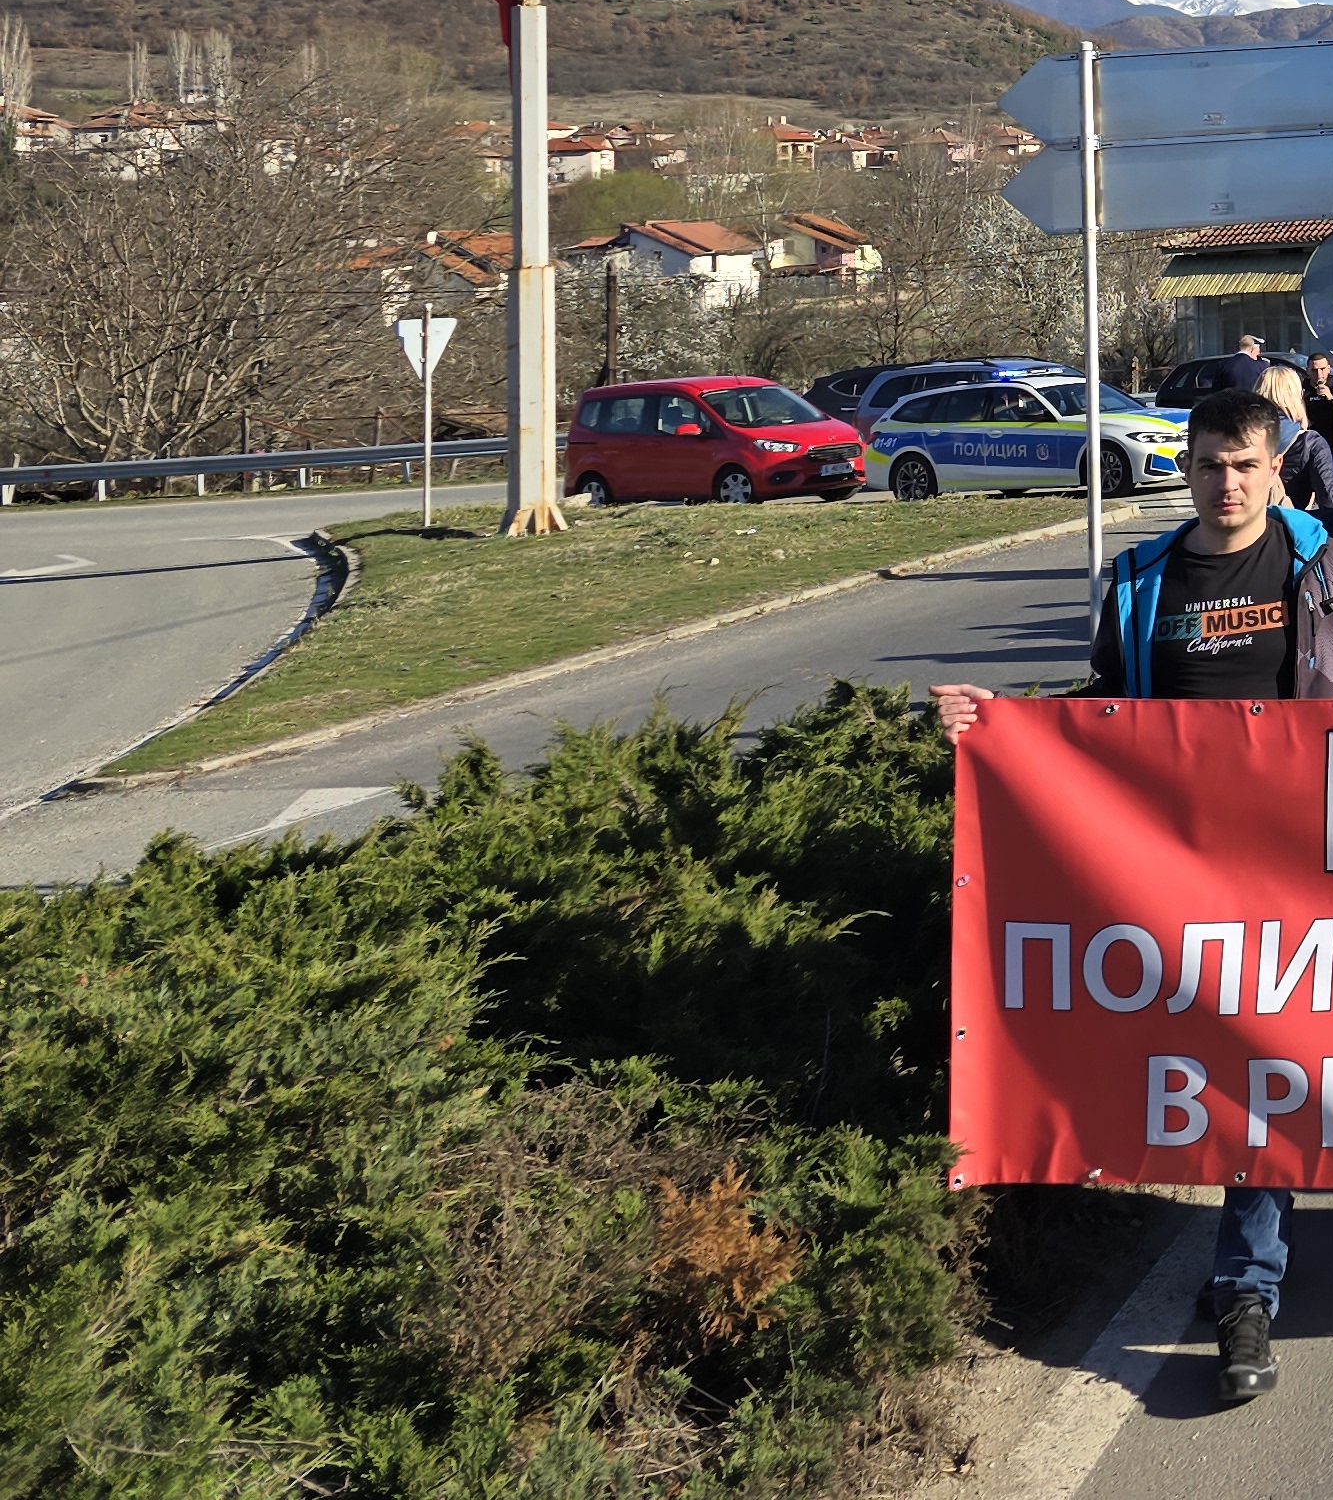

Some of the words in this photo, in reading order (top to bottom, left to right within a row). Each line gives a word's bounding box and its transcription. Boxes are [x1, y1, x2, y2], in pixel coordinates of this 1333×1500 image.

[953, 441, 1028, 459] ПОЛИЦИЯ
[1185, 596, 1255, 613] UNIVERSAL
[1157, 617, 1199, 638] OFF
[1206, 606, 1284, 634] MUSIC
[1187, 634, 1254, 655] California
[1146, 1055, 1210, 1147] В
